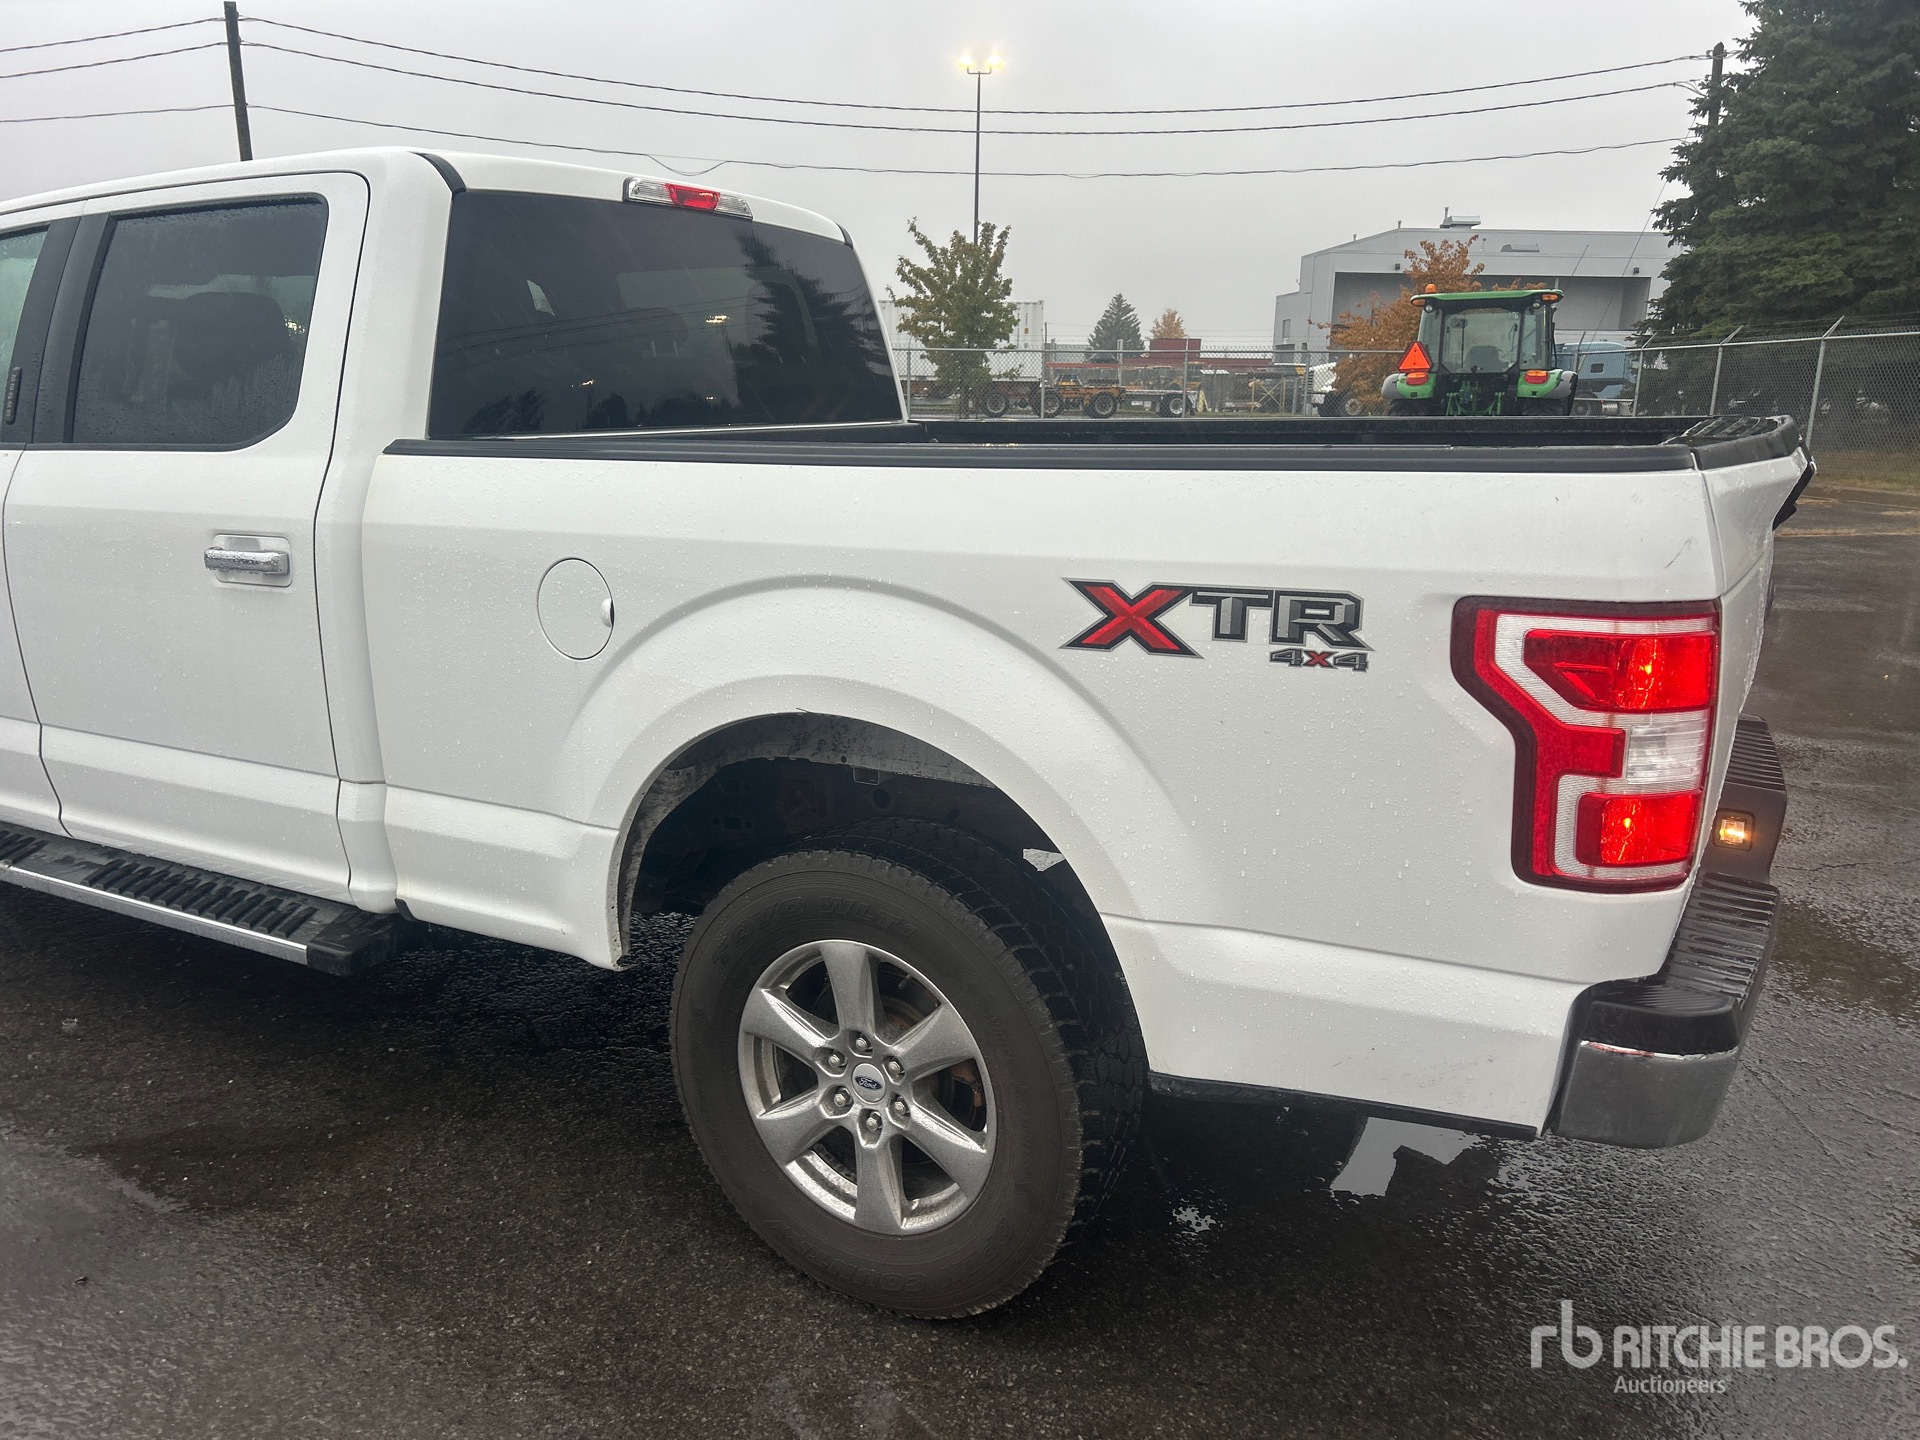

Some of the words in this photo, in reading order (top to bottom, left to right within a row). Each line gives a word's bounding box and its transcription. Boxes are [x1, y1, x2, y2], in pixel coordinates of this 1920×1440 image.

[1058, 577, 1375, 659] XTR
[711, 896, 807, 965] TOYO
[857, 1077, 879, 1089] Ford
